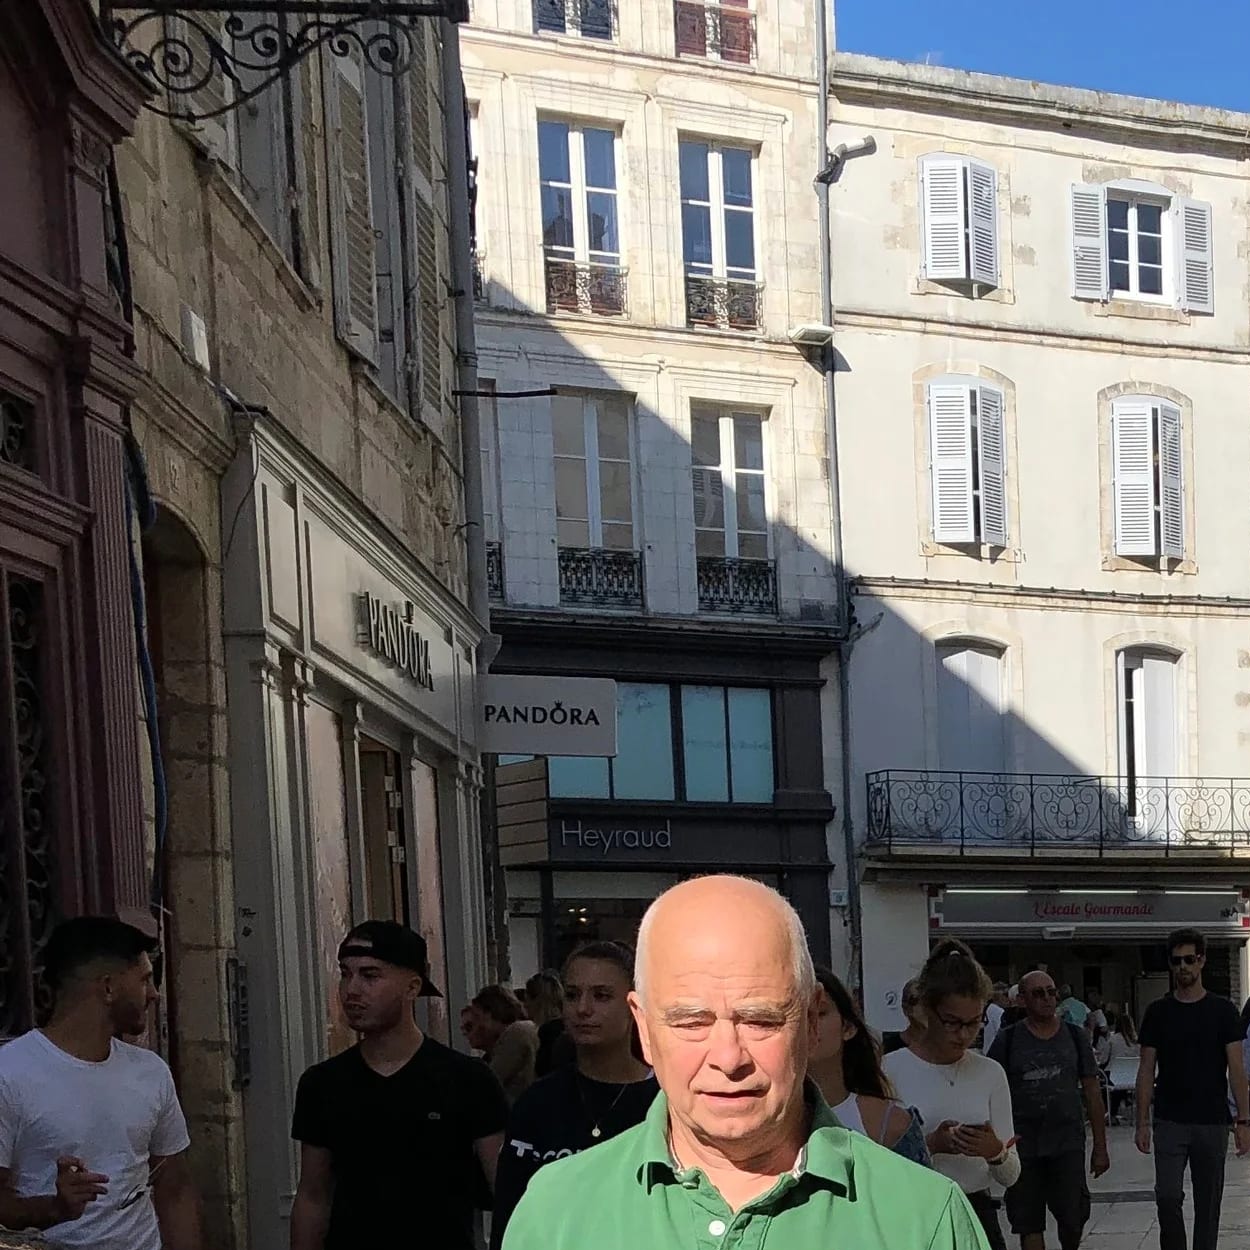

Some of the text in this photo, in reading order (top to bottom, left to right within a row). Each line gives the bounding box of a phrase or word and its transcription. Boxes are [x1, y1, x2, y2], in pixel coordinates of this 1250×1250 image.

[484, 700, 600, 726] PANDORA
[561, 820, 672, 855] Heyraud
[1085, 902, 1154, 917] Gourmande
